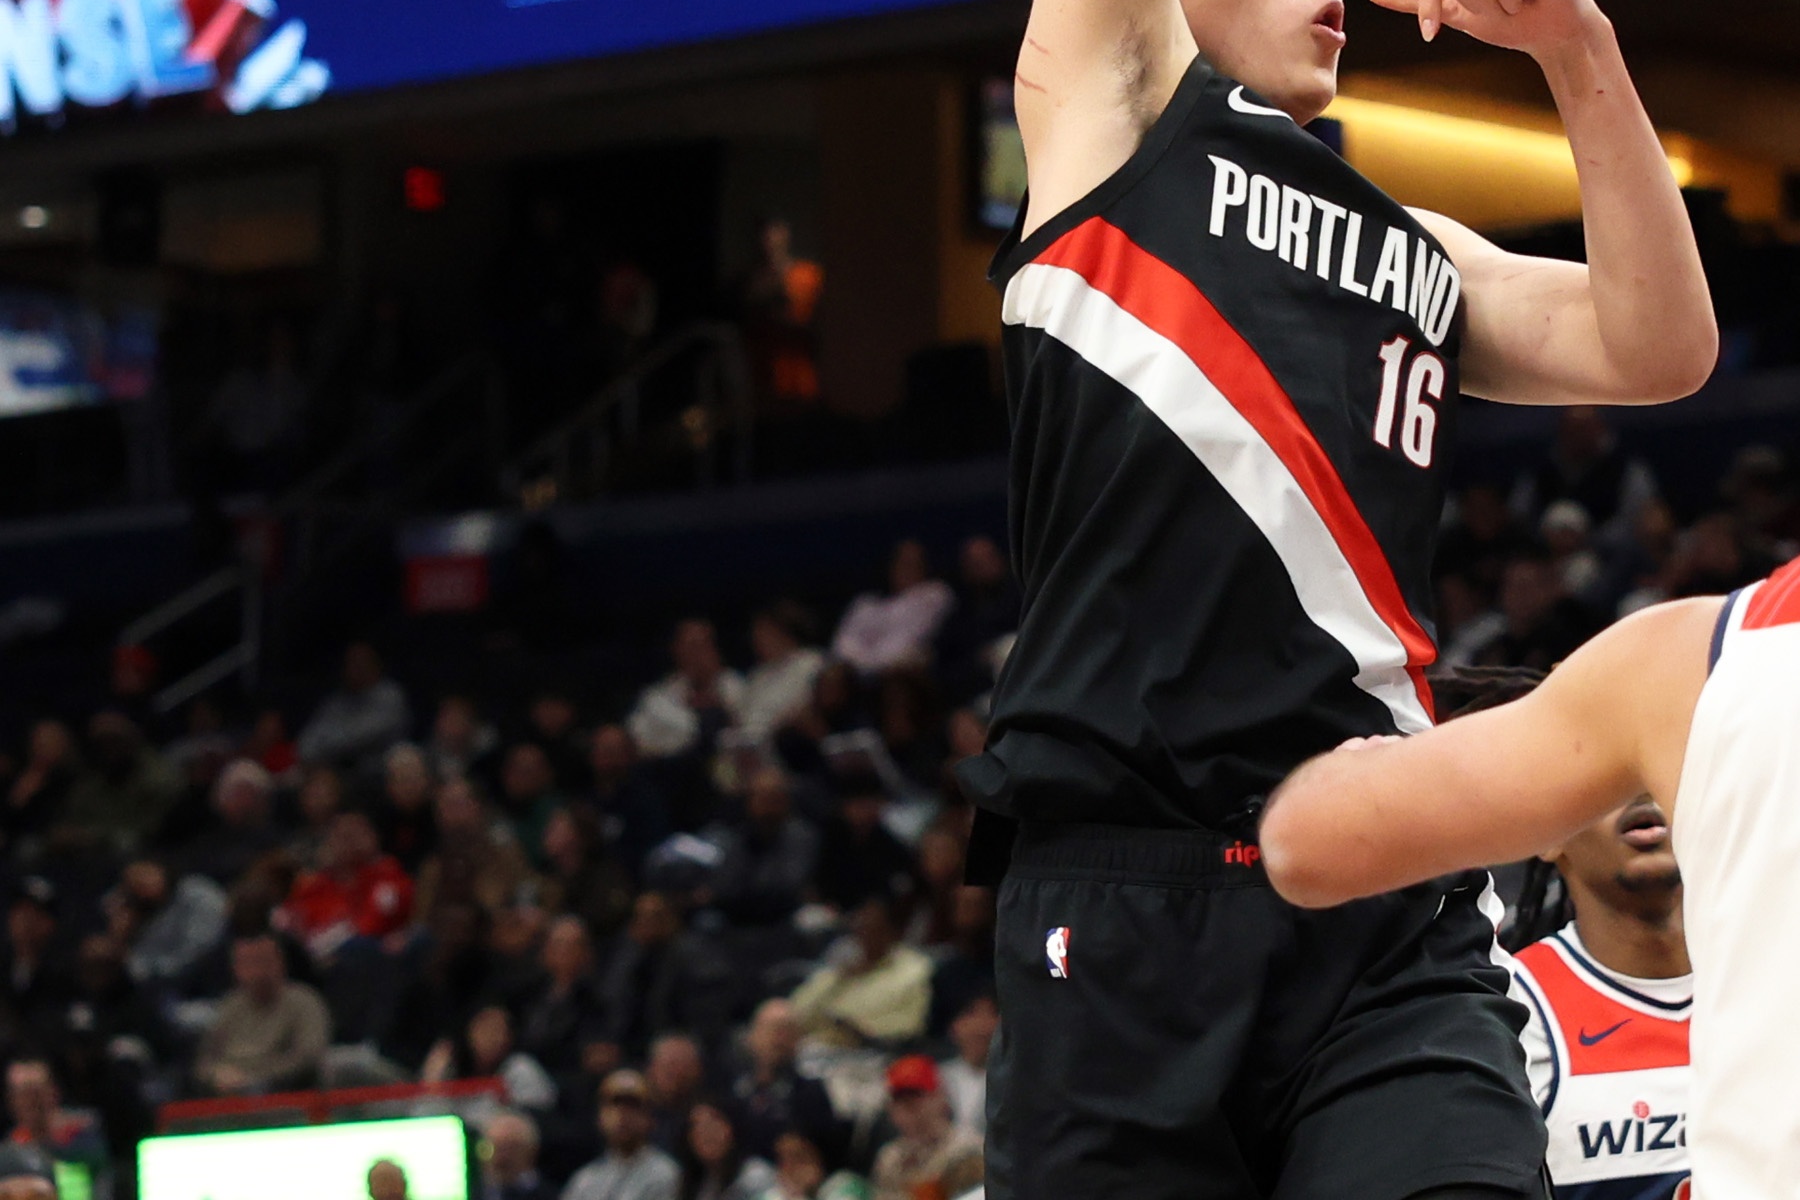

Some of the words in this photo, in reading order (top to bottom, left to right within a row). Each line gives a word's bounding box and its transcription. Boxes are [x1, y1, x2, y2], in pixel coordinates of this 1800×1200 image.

[1207, 153, 1462, 348] PORTLAND
[1373, 334, 1445, 469] 16
[1578, 1100, 1686, 1159] wiz
